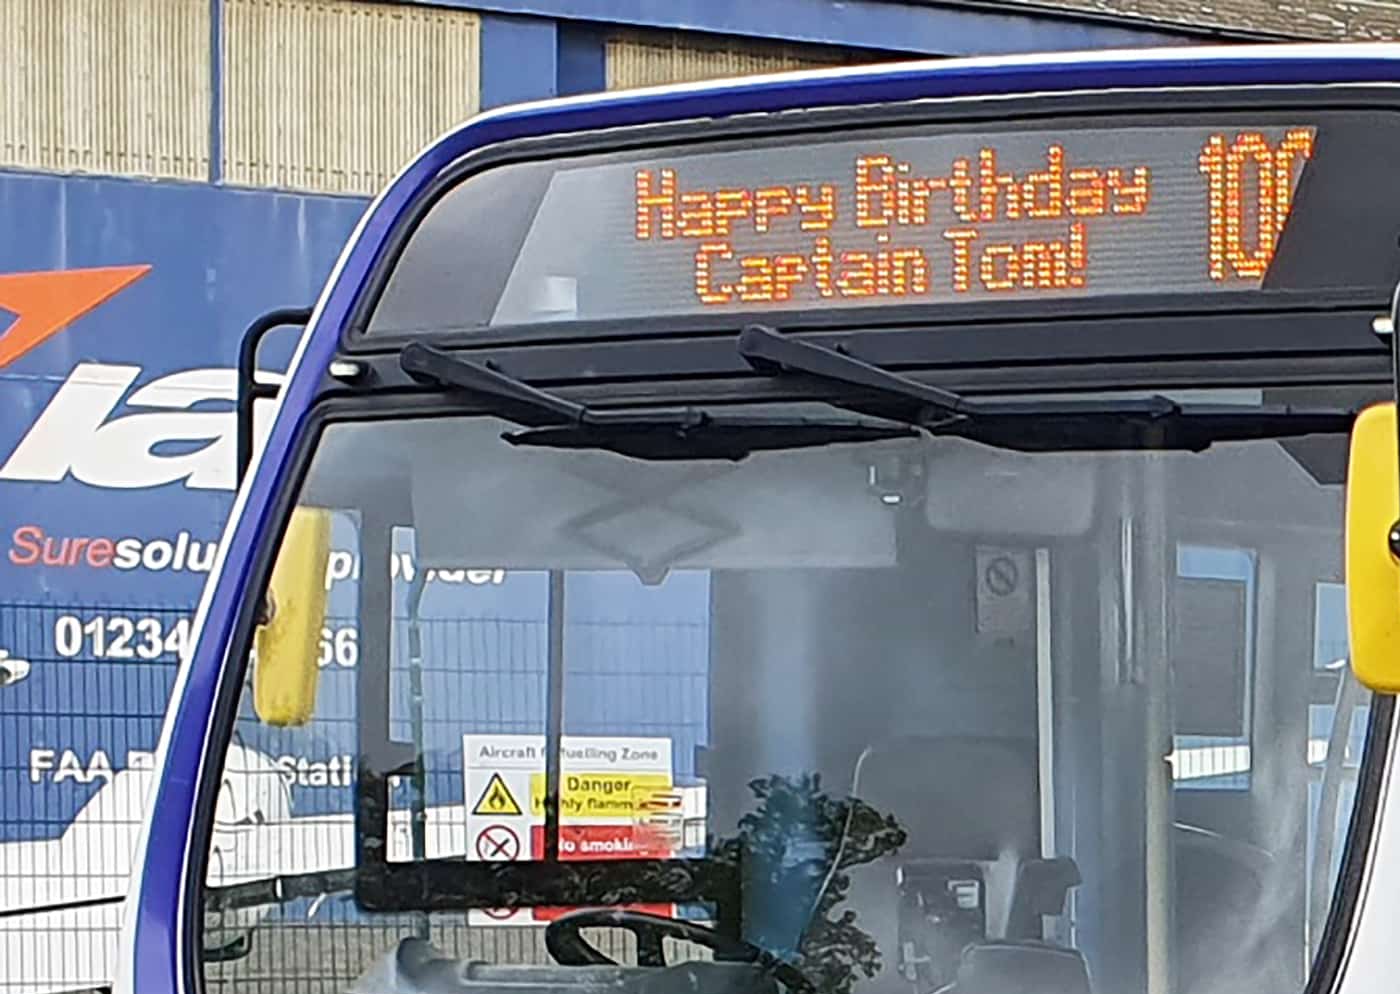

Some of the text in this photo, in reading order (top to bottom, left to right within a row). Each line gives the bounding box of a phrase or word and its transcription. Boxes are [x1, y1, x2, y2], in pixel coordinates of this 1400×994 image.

[635, 144, 1151, 240] Happy Birthday
[695, 222, 1088, 303] Captain Tom!
[30, 749, 113, 783] FAA
[480, 745, 536, 760] Aircraft
[621, 748, 659, 761] Zone
[567, 776, 632, 795] Danger
